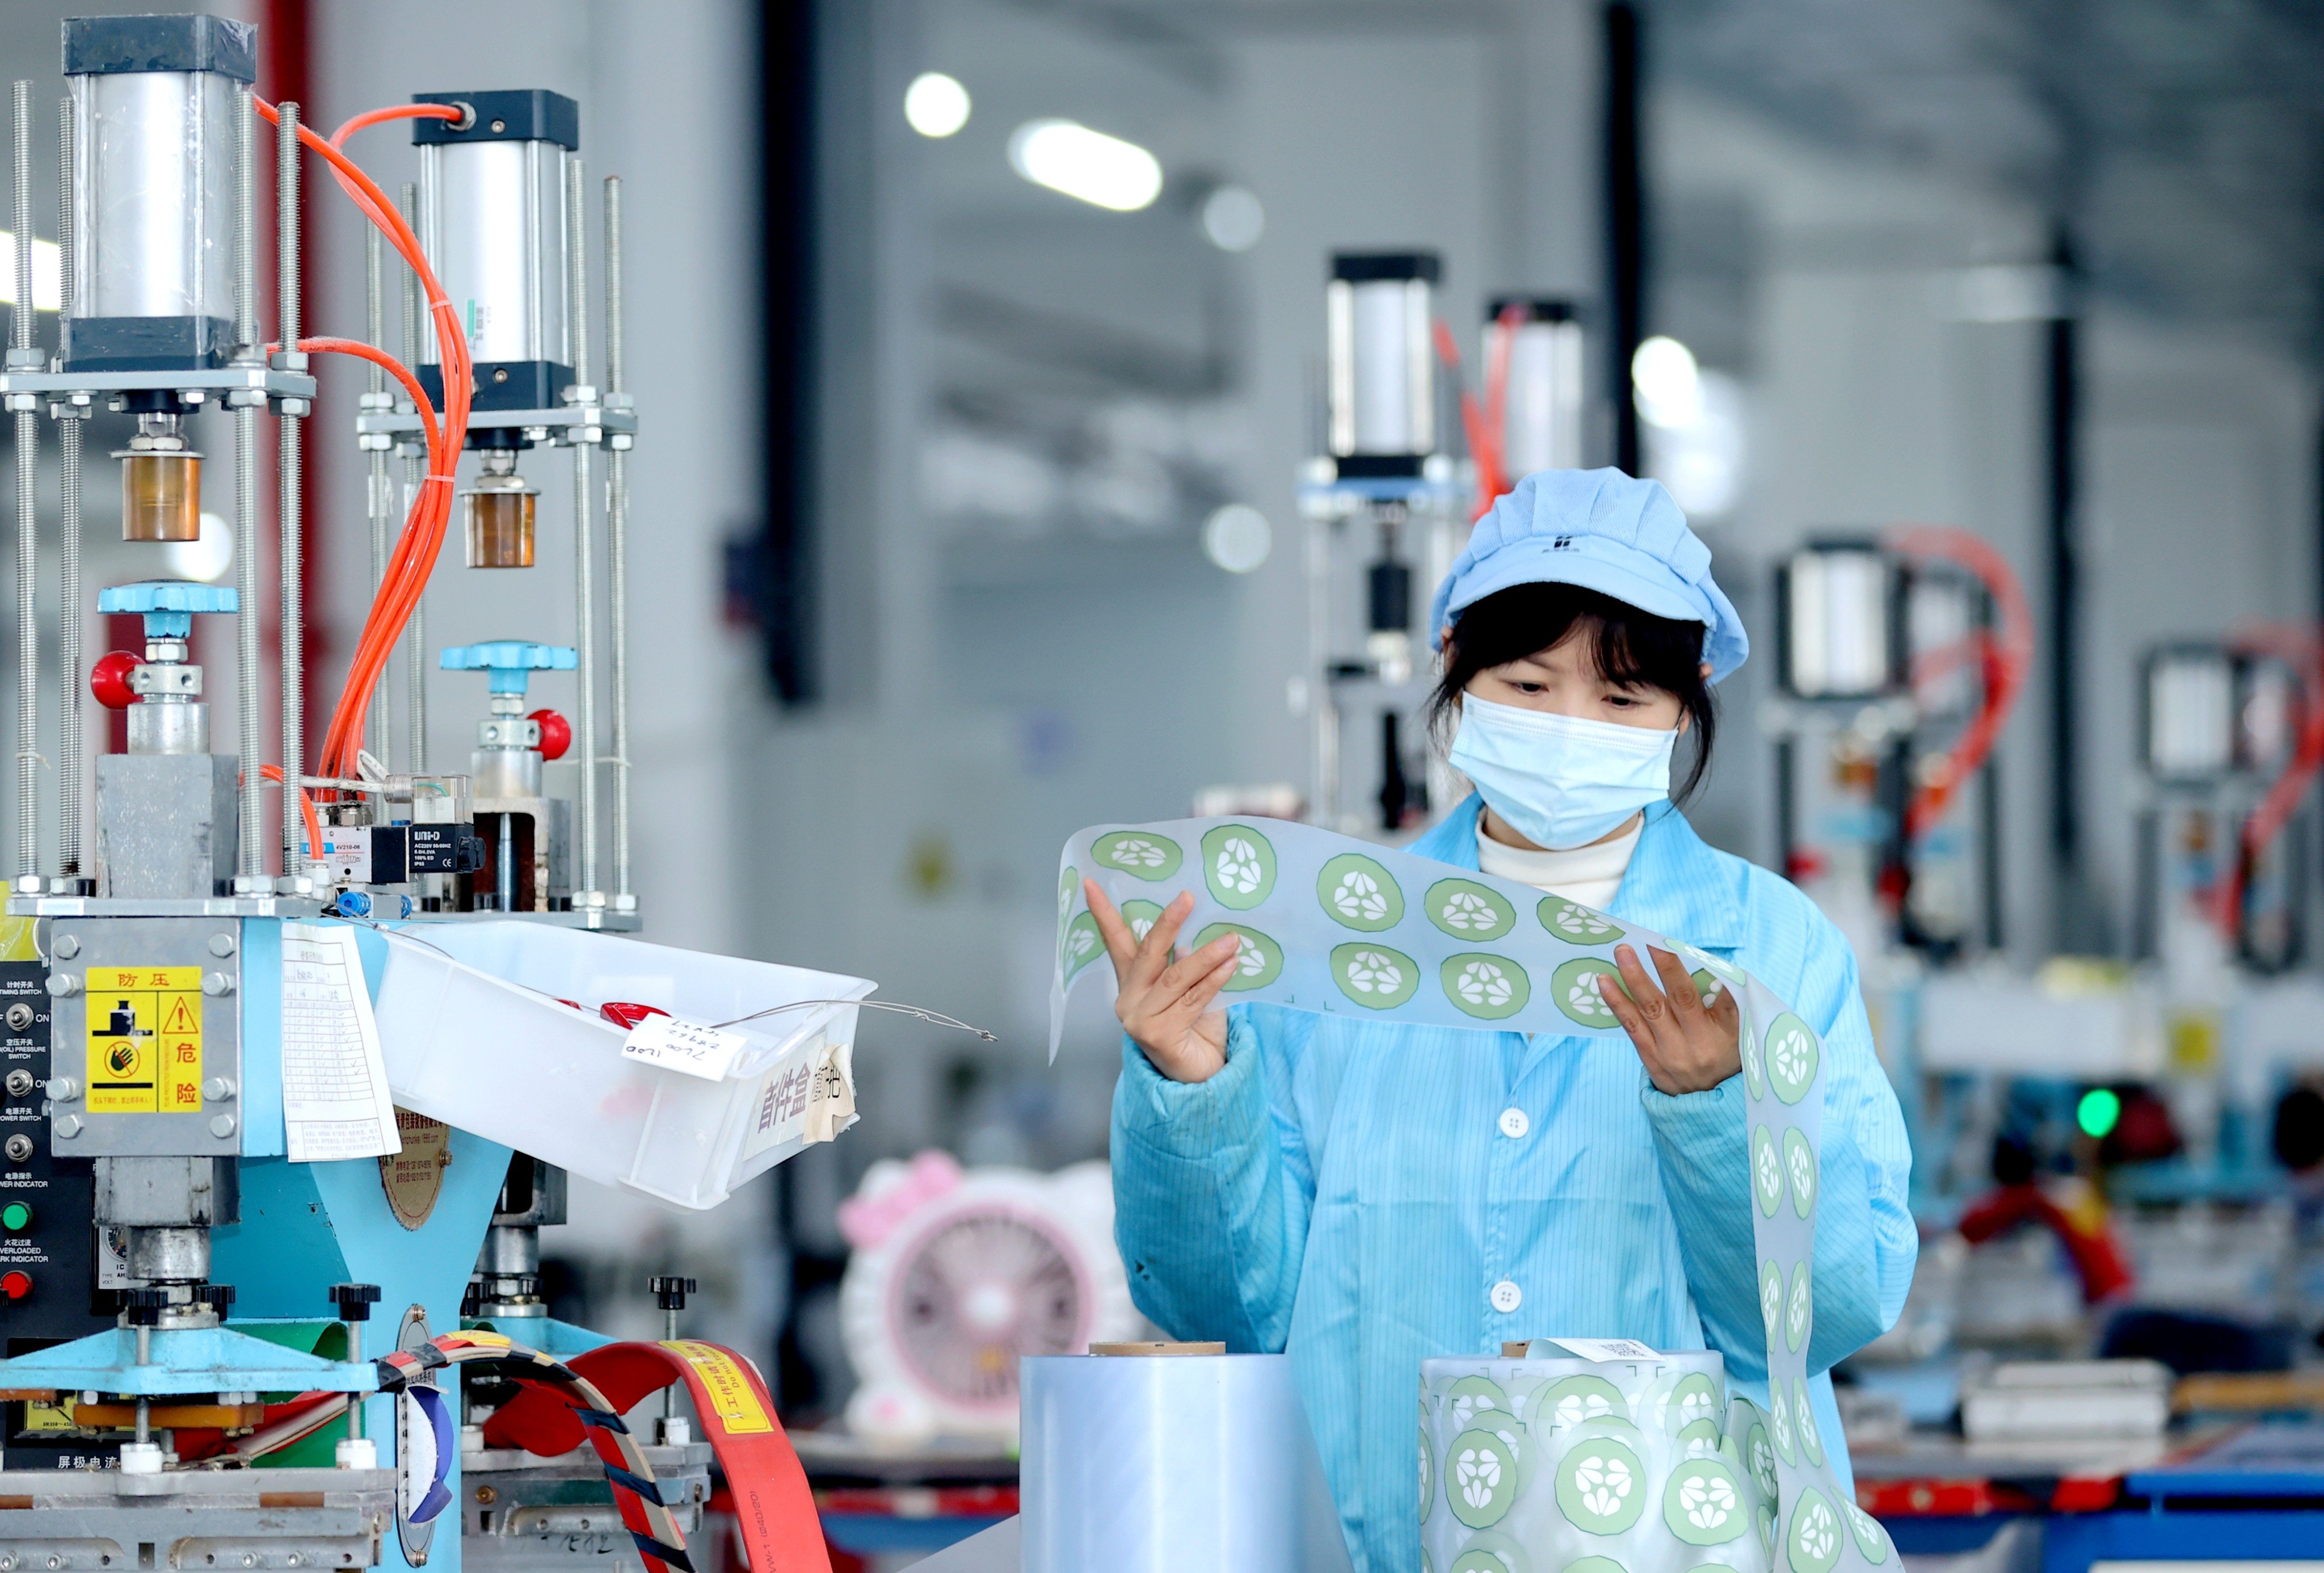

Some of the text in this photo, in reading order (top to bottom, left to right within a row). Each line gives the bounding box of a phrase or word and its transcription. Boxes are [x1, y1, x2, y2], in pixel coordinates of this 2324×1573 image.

[118, 973, 170, 987] 防压
[35, 1014, 49, 1023] ON
[177, 1042, 196, 1104] 危险
[719, 1362, 731, 1374] not
[730, 1377, 739, 1387] Do
